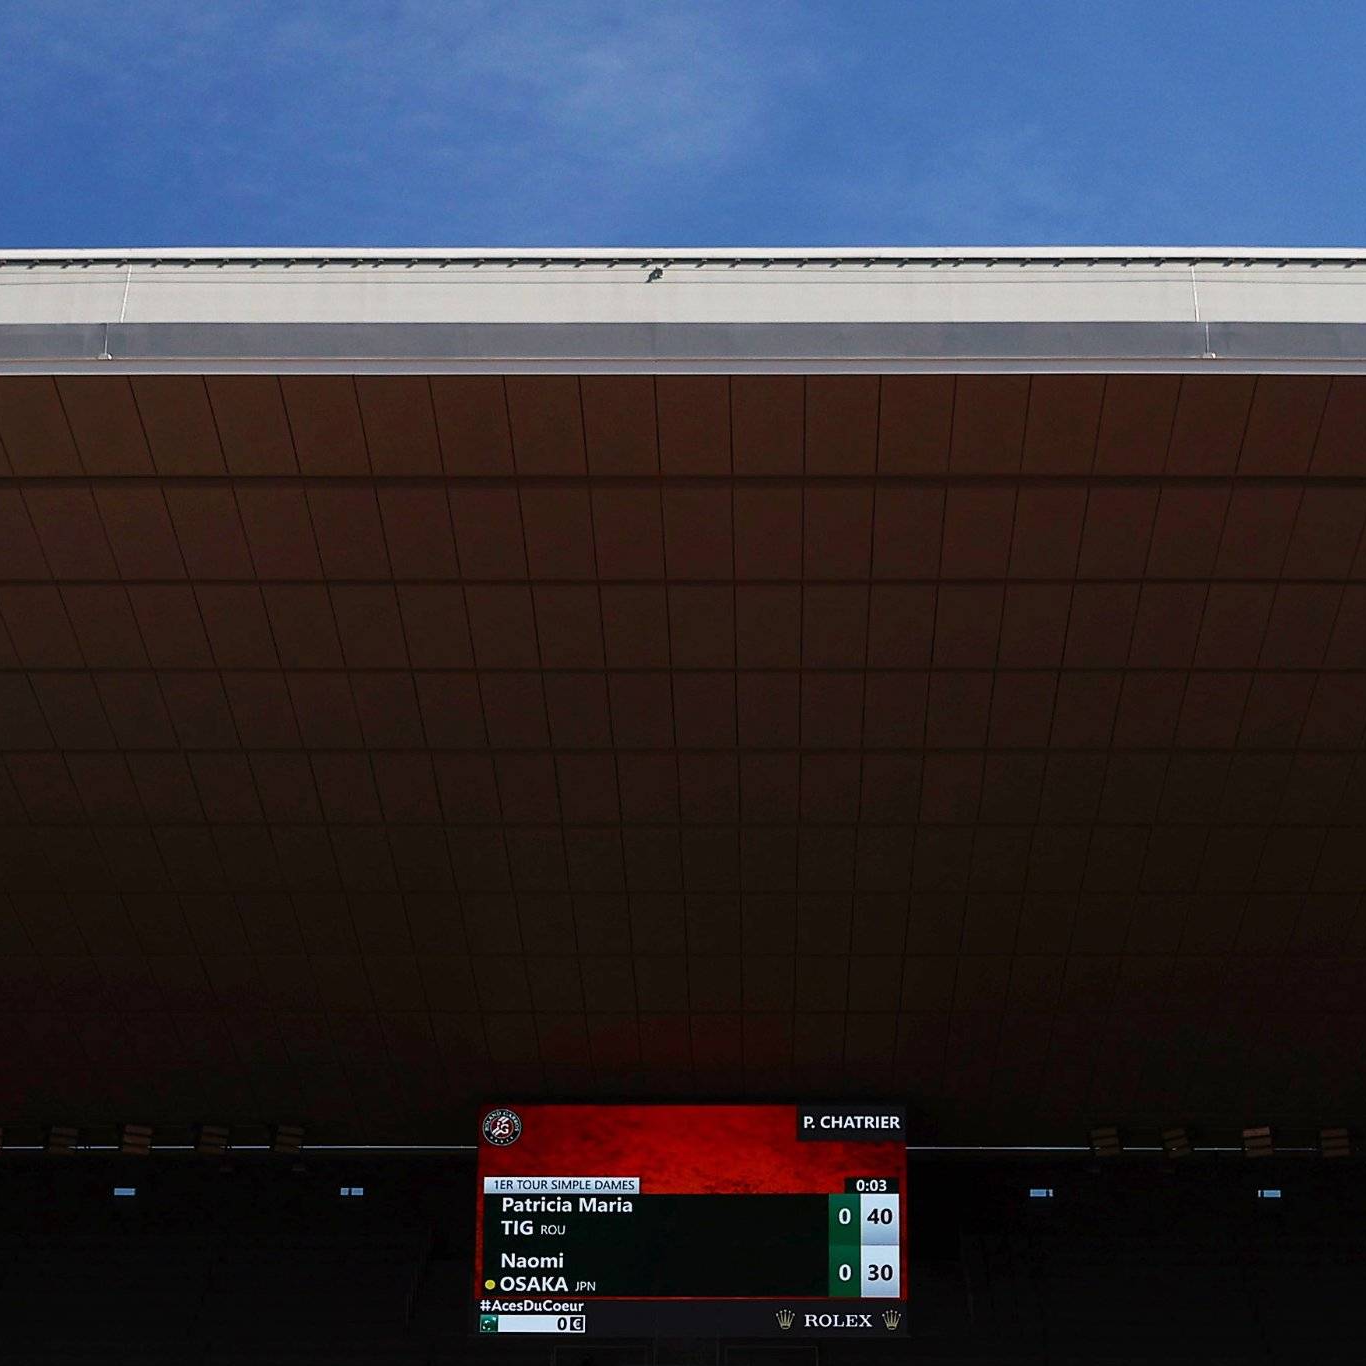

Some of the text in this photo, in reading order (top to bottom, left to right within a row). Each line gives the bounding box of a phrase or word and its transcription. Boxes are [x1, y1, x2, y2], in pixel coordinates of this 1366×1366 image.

[803, 1116, 901, 1129] P. CHATRIER
[494, 1180, 635, 1190] 1ER TOUR SIMPLE DAMES
[856, 1180, 888, 1192] 0:03
[501, 1197, 633, 1213] Patricia Maria
[838, 1208, 893, 1224] 0 40
[501, 1221, 566, 1236] TIG ROU
[501, 1253, 564, 1268] Naomi
[838, 1265, 894, 1281] 0 30
[500, 1277, 596, 1293] OSAKA JPN
[480, 1300, 585, 1313] #AcesDuCoeur
[557, 1317, 568, 1331] 0
[804, 1314, 873, 1328] ROLEX
